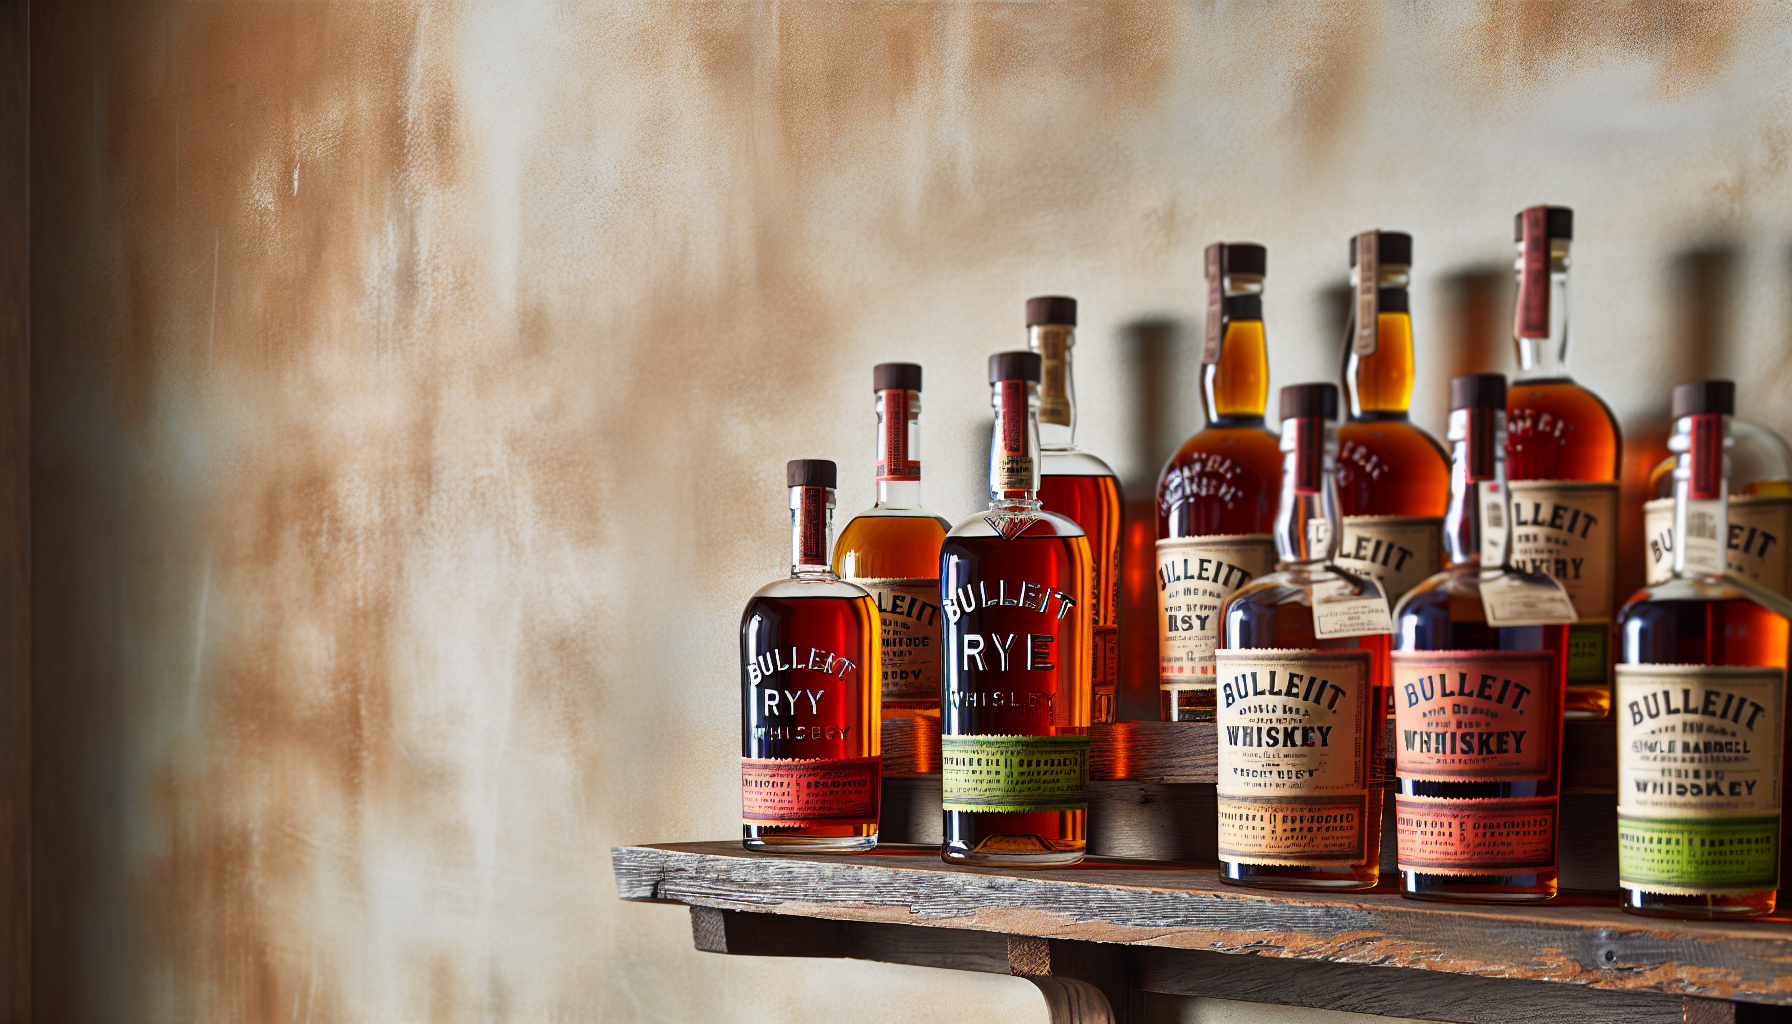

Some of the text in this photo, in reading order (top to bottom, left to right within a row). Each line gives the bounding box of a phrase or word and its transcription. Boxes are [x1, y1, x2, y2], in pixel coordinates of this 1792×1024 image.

[963, 633, 1056, 672] RYE
[764, 688, 825, 717] RYY
[1226, 725, 1333, 748] WHISKEY
